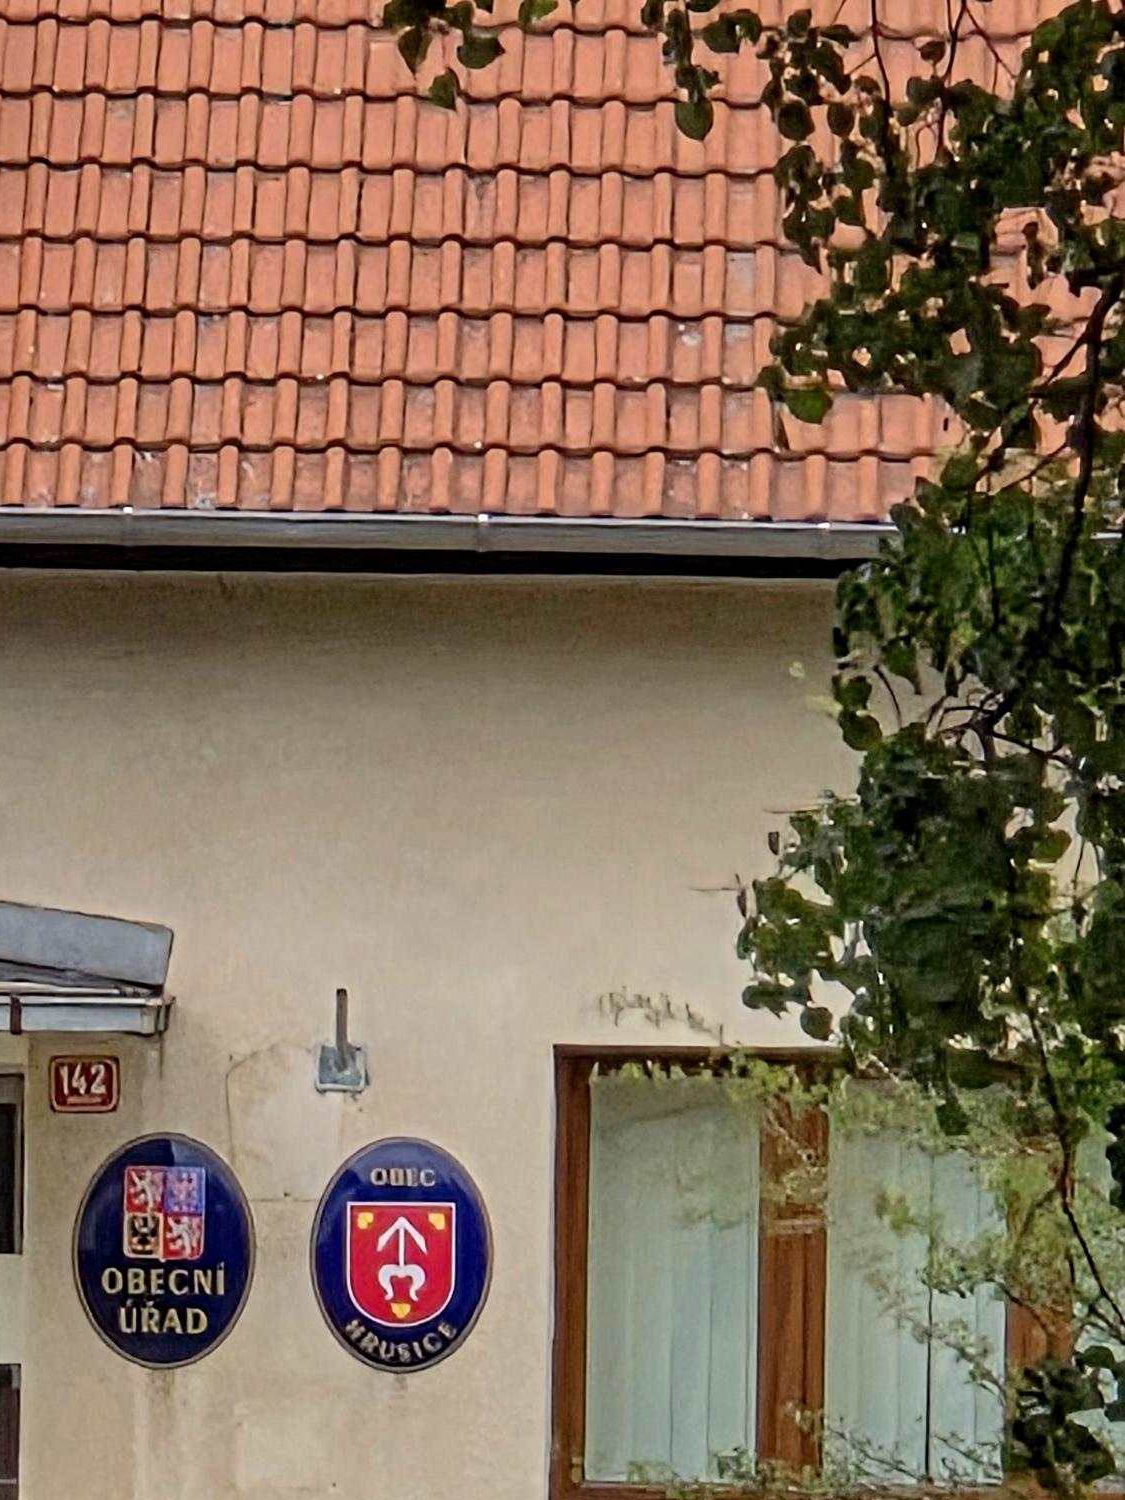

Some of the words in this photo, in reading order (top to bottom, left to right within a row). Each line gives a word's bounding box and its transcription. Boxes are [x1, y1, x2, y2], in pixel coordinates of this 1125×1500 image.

[59, 1062, 107, 1096] 142
[370, 1167, 436, 1187] OBEC
[100, 1261, 225, 1296] OBECNÍ
[118, 1298, 208, 1334] ÚŘAD
[344, 1319, 458, 1363] HRUSICE
